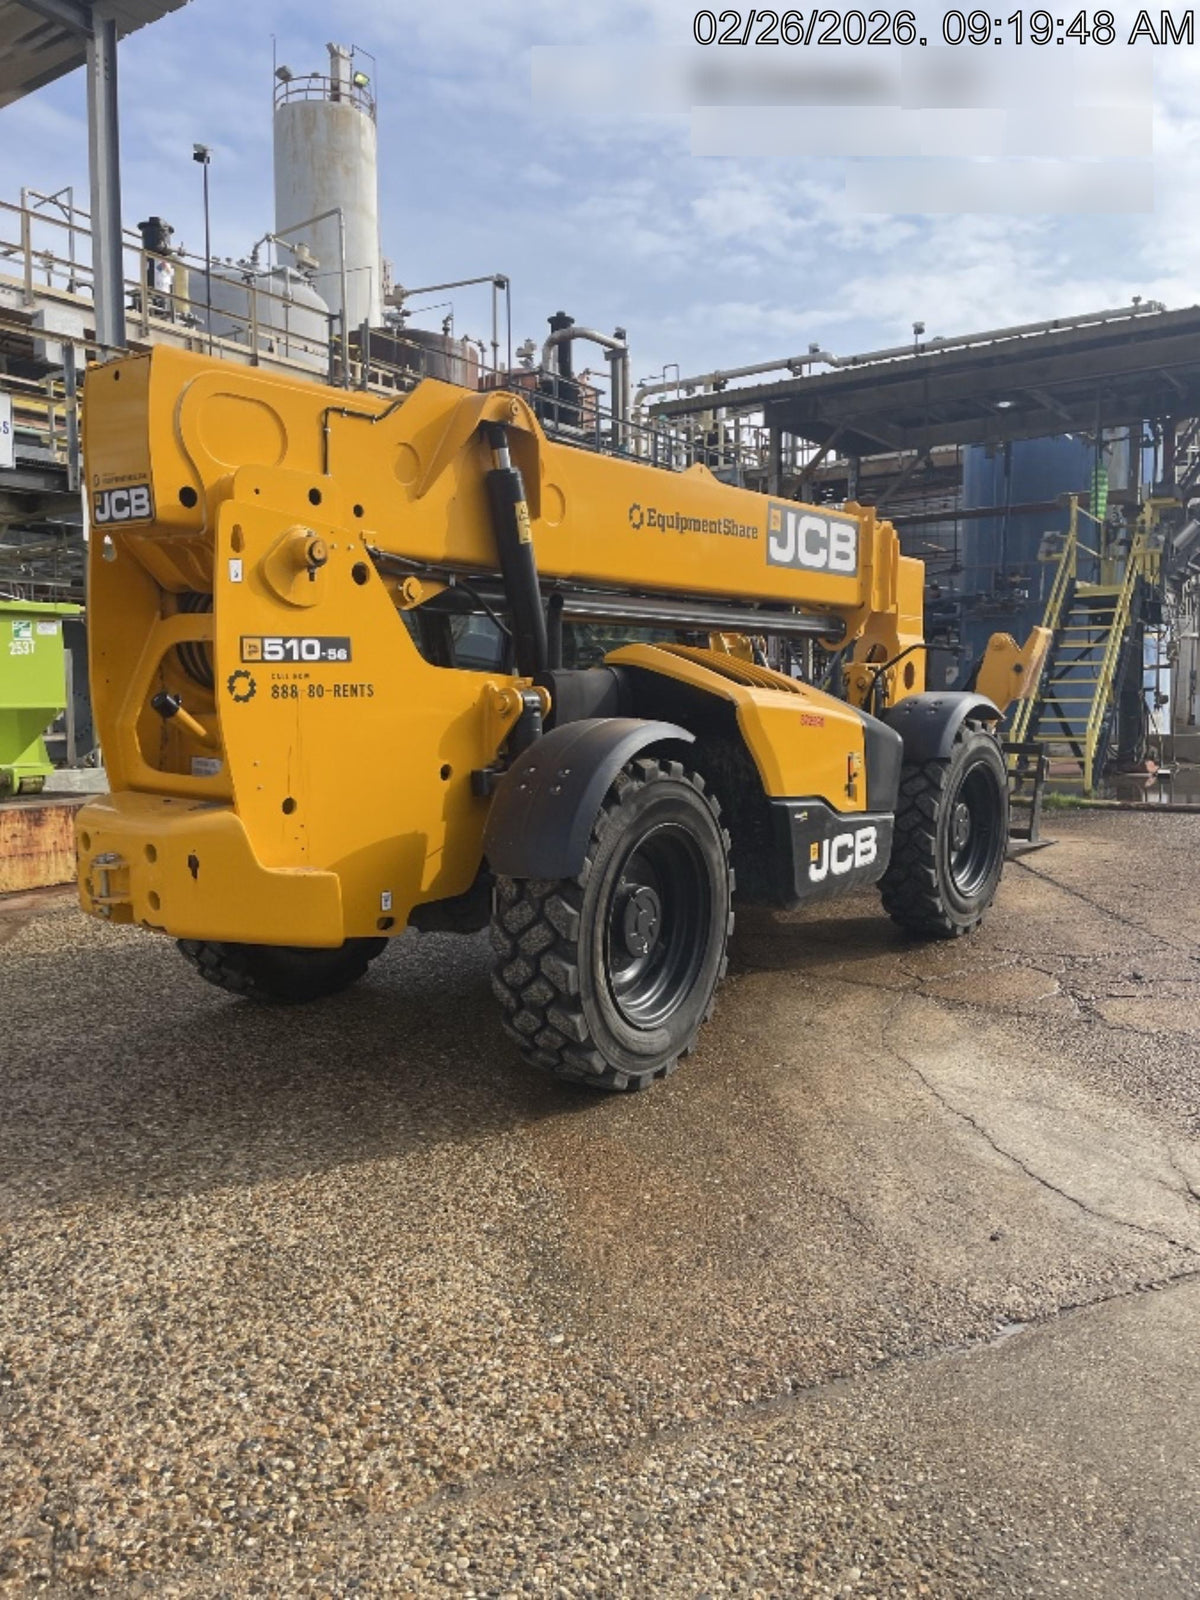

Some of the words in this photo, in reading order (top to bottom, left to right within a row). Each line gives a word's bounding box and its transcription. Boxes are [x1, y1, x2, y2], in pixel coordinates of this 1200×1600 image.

[96, 486, 150, 521] JCB
[646, 508, 759, 540] EquipmentShare
[769, 512, 857, 572] JCB
[809, 826, 877, 882] JCB
